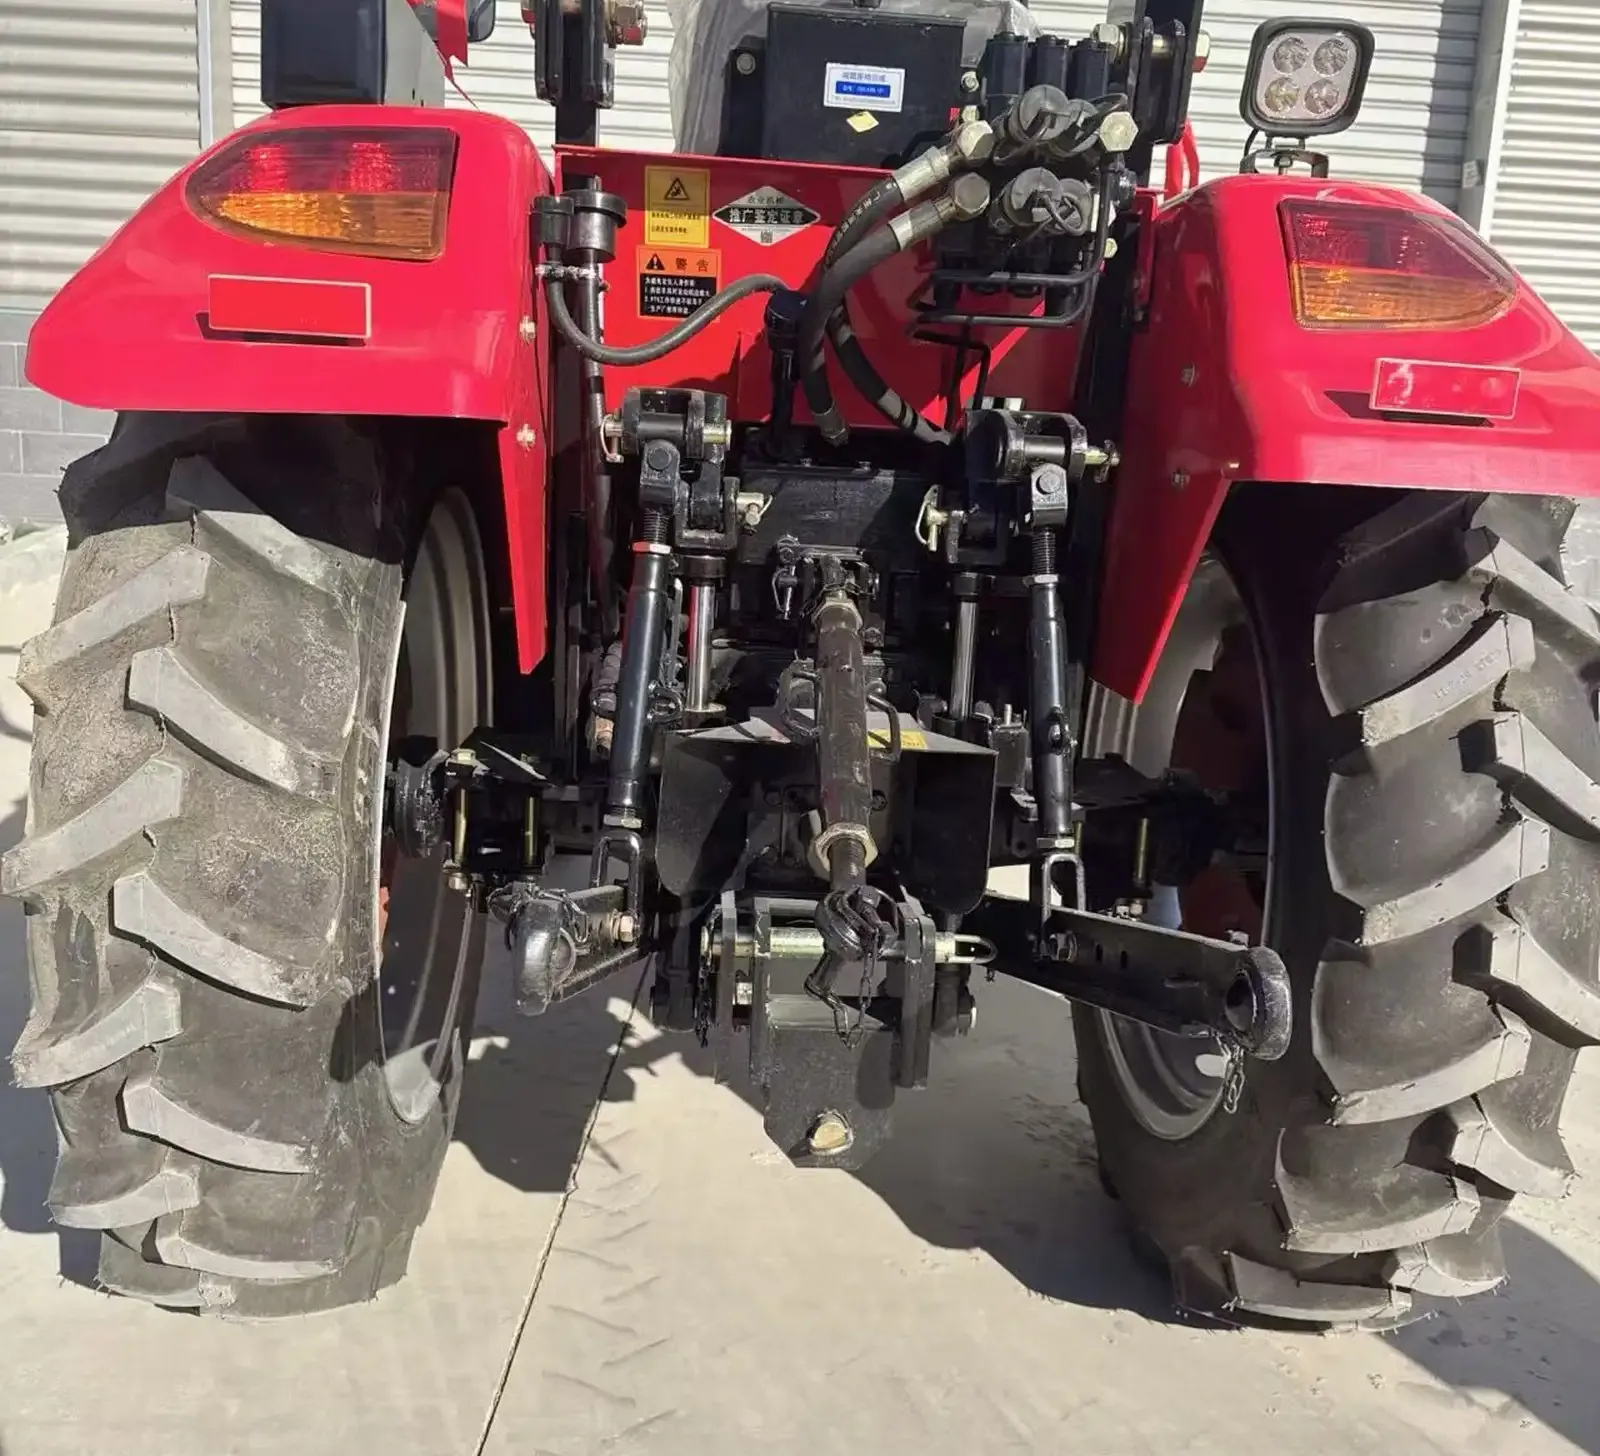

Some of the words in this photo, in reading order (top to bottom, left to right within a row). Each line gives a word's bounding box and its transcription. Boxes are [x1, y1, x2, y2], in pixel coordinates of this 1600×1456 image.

[729, 208, 805, 223] 推广鉴定证章
[675, 257, 710, 272] 警告
